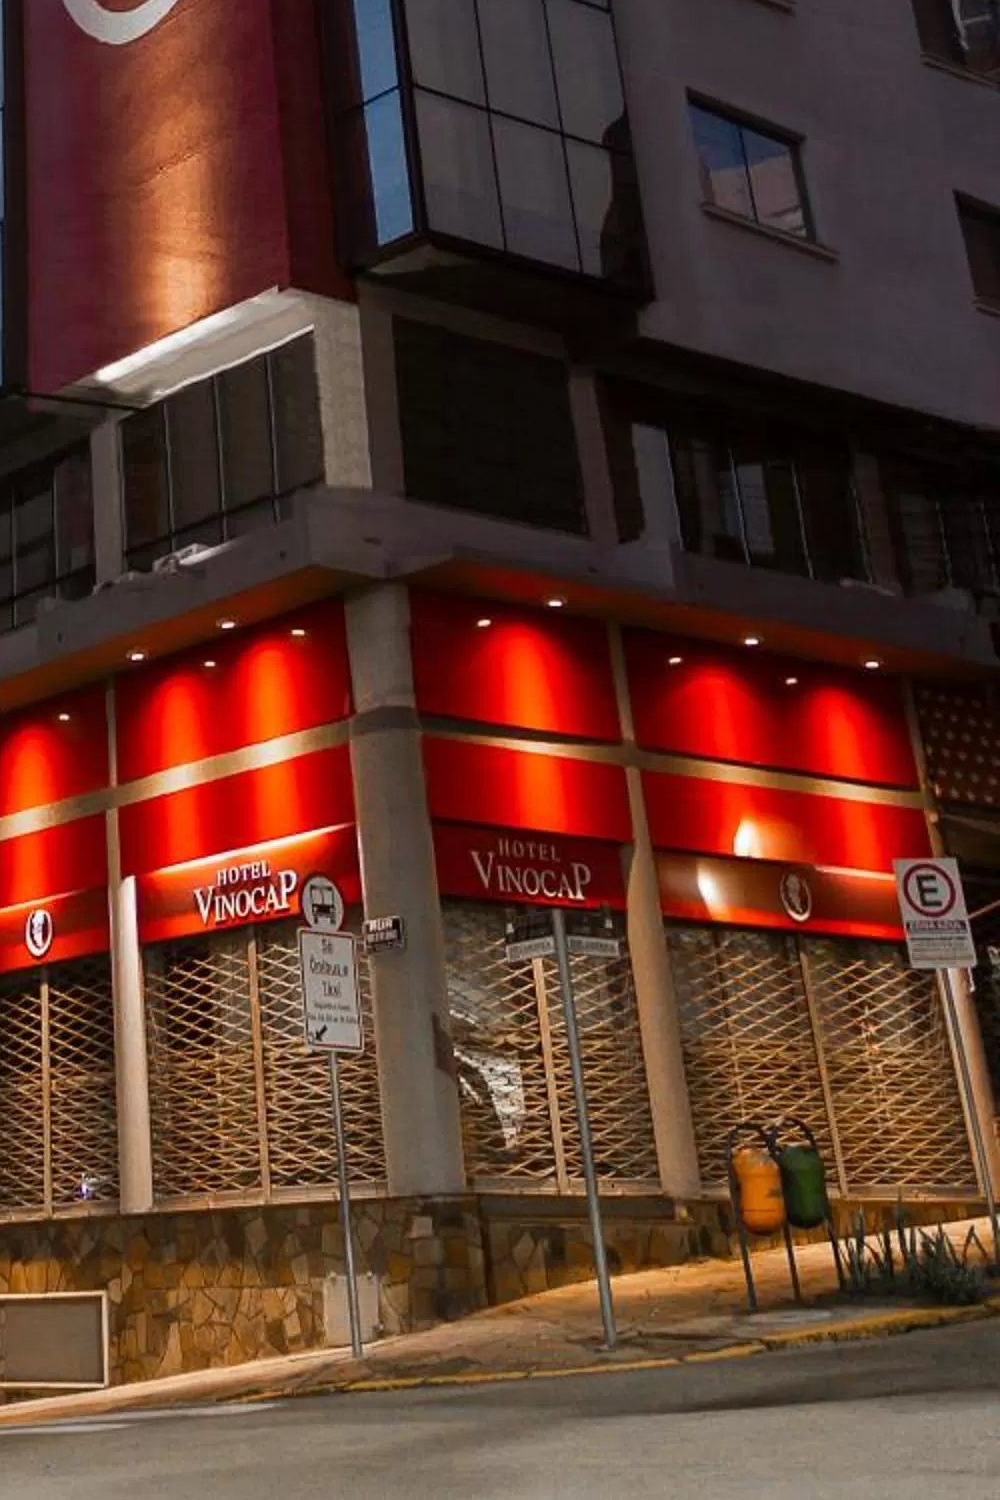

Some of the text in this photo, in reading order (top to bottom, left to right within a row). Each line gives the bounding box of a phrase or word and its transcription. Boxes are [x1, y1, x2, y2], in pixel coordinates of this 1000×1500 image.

[499, 838, 562, 864] HOTEL
[216, 860, 271, 888] HOTEL
[470, 850, 592, 901] VINOCAP
[915, 873, 943, 908] E
[193, 869, 298, 925] VINOCAP
